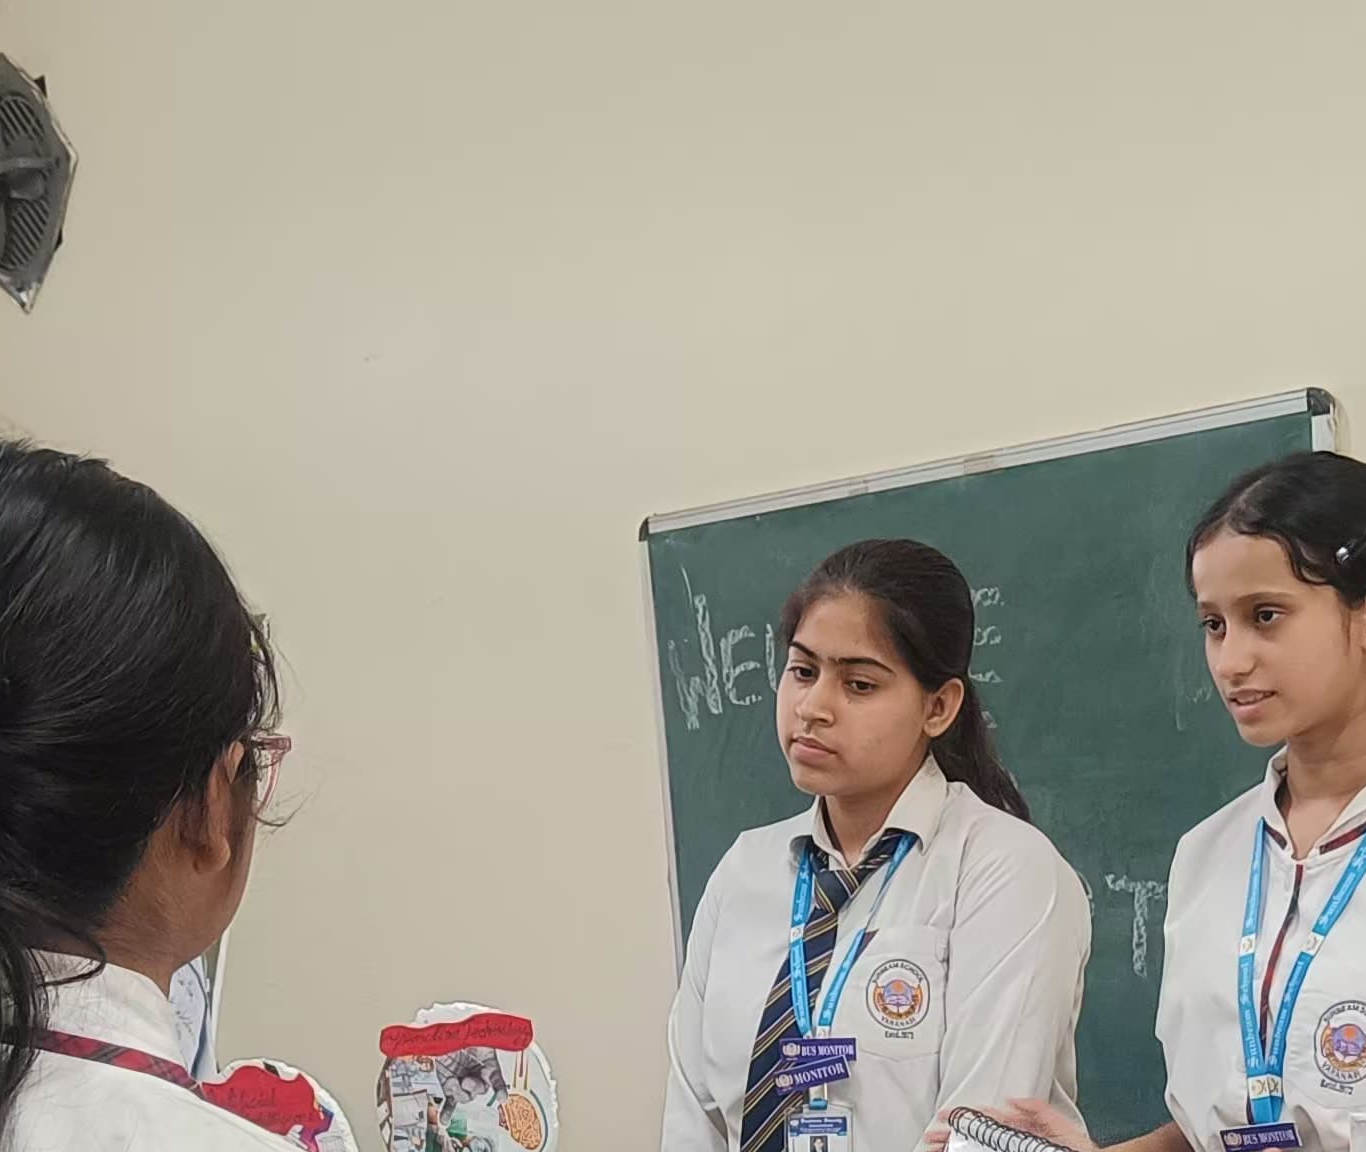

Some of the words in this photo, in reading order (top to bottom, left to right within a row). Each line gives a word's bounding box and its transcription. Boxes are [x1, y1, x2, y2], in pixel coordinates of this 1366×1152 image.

[801, 1045, 817, 1057] BUS
[817, 1044, 855, 1056] MONITOR
[793, 1062, 845, 1085] MONITOR
